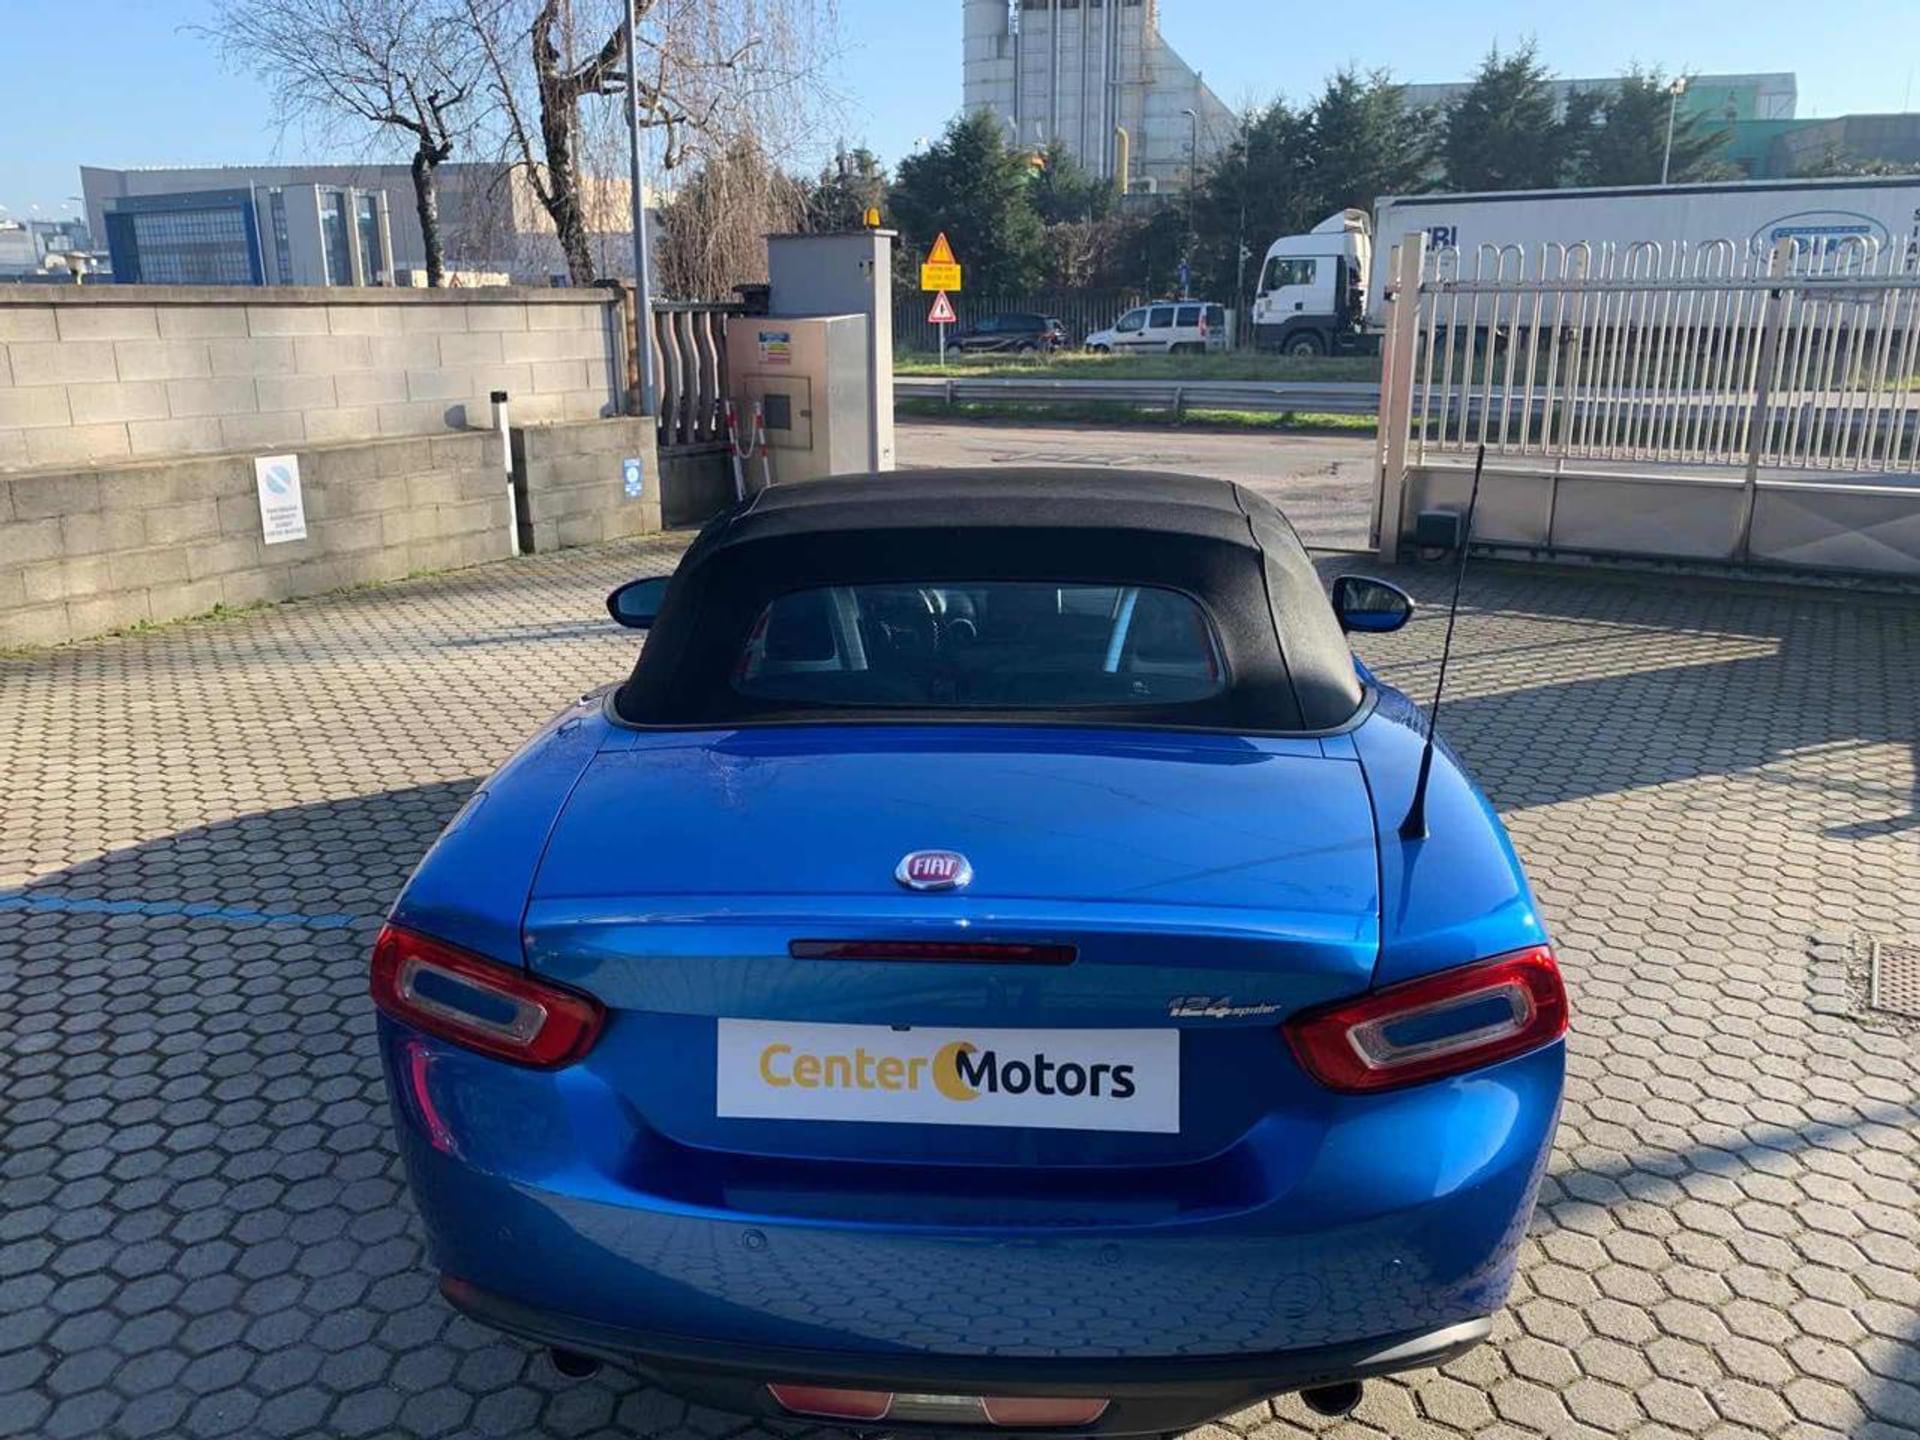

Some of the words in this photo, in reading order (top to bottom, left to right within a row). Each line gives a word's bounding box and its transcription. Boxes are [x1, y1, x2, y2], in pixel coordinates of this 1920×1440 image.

[912, 857, 957, 876] FIAT
[1168, 996, 1232, 1018] 124
[759, 1043, 927, 1091] Center
[955, 1050, 1136, 1099] Motors
